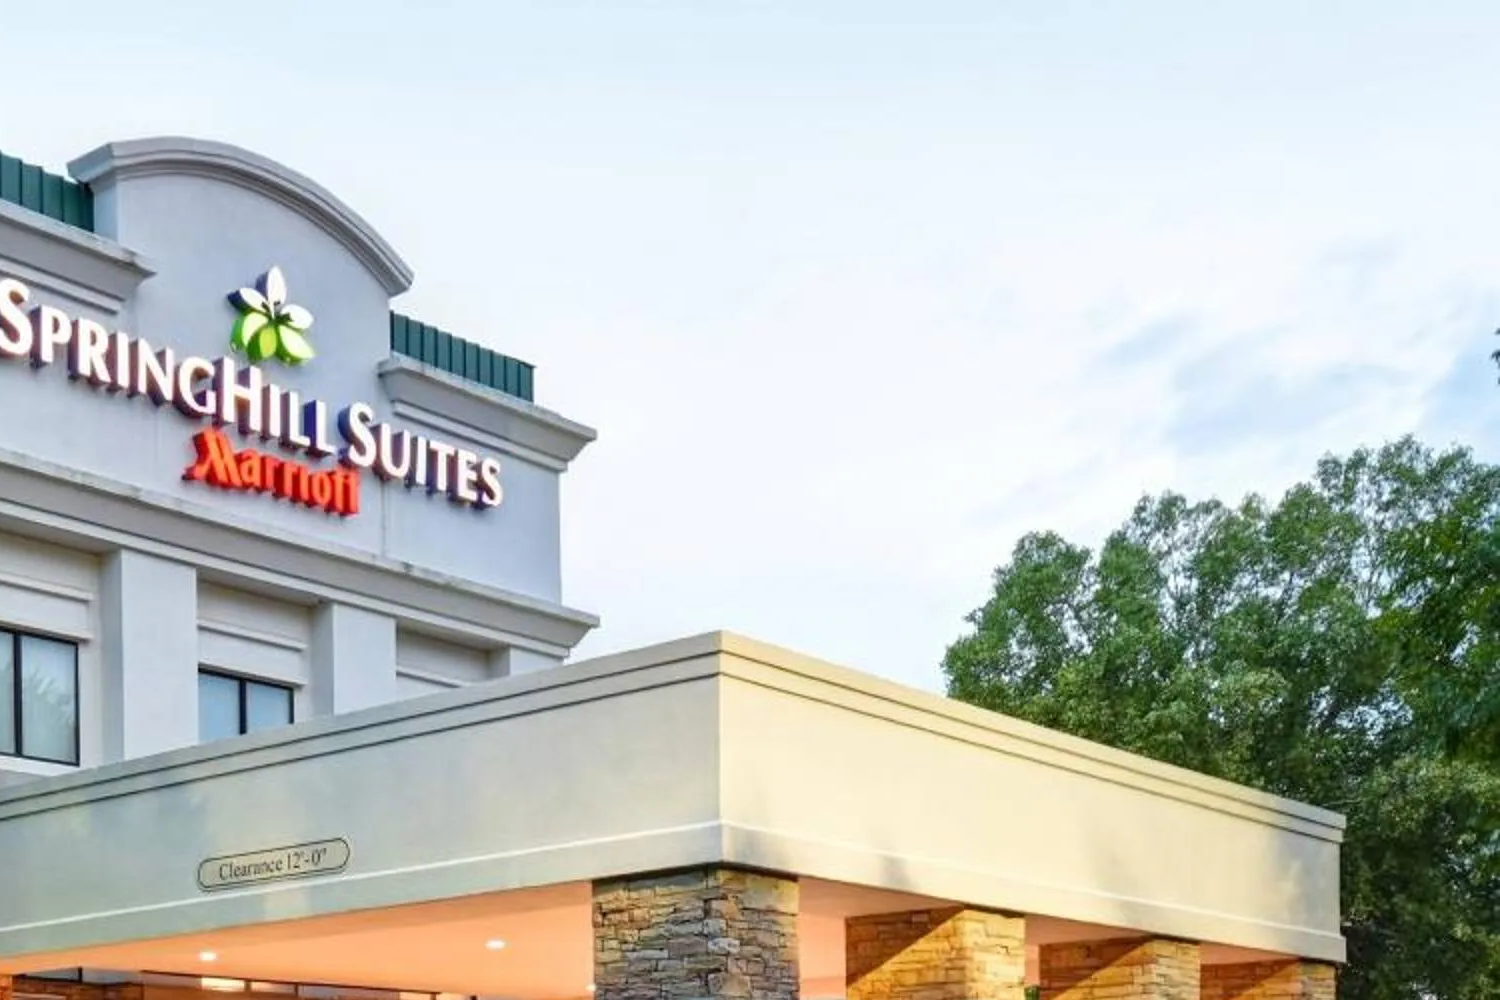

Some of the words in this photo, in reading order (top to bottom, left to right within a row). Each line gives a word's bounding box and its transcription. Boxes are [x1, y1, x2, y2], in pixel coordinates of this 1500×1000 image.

[184, 425, 361, 516] Marriott
[337, 402, 504, 509] SUITES
[218, 858, 284, 881] Clearance
